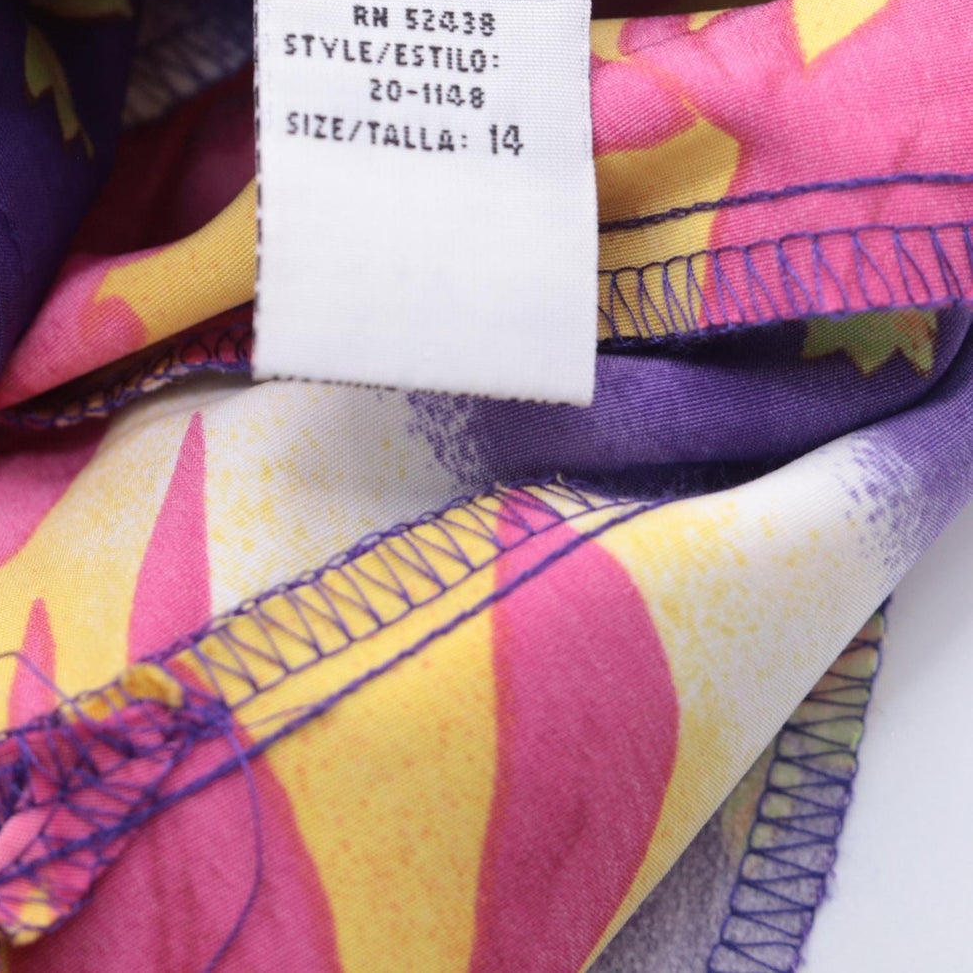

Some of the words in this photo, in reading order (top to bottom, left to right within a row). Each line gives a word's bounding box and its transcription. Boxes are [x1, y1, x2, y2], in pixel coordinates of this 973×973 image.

[353, 5, 388, 27] RN
[405, 8, 496, 37] 52438
[284, 33, 499, 73] STYLE/ESTILO:
[370, 79, 485, 108] 20-1148
[286, 111, 468, 151] SIZE/TALLA:
[489, 124, 524, 156] 14
